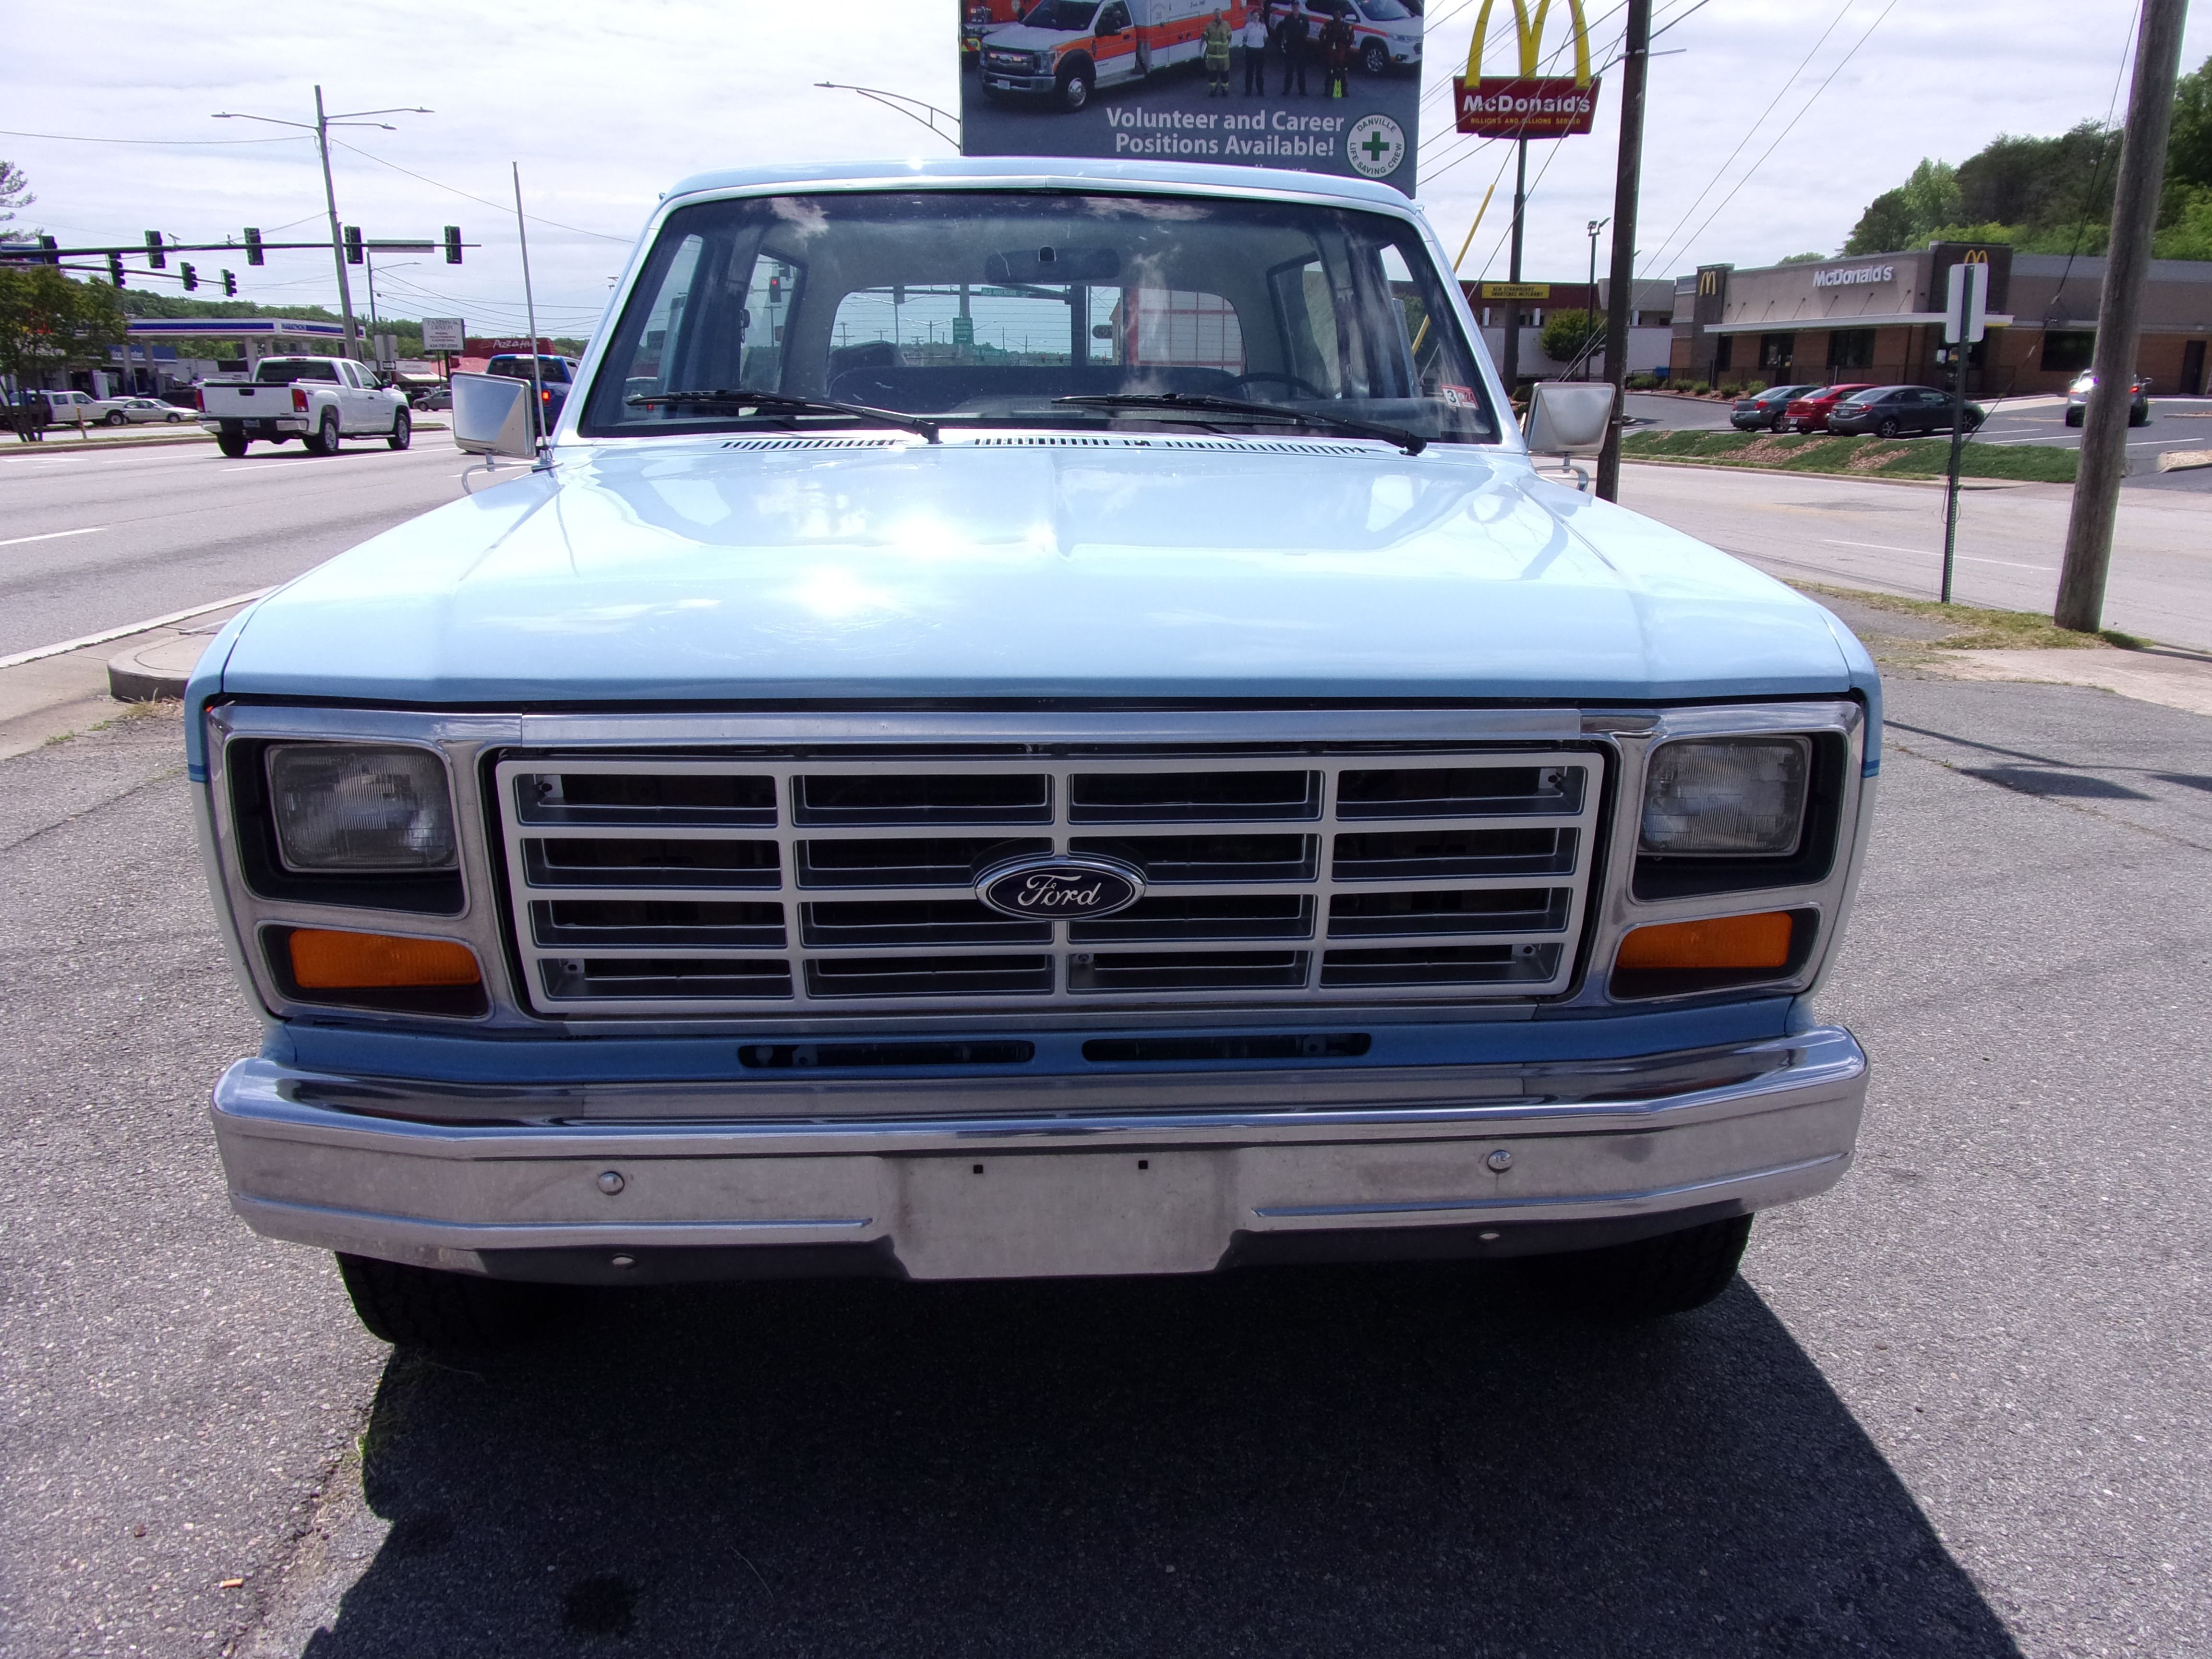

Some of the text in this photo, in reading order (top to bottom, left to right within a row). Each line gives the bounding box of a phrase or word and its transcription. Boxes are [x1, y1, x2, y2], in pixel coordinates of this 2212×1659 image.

[1463, 95, 1590, 112] McDonald's
[1106, 107, 1345, 132] Volunteer and Career
[1357, 118, 1397, 132] DANVILLE
[1116, 132, 1334, 156] Positions Available!
[1350, 143, 1402, 175] LIFE SAVING CREW
[1812, 264, 1894, 287] McDonald's
[493, 340, 519, 349] Pizza
[1447, 390, 1456, 403] 3
[1018, 874, 1102, 906] Ford
